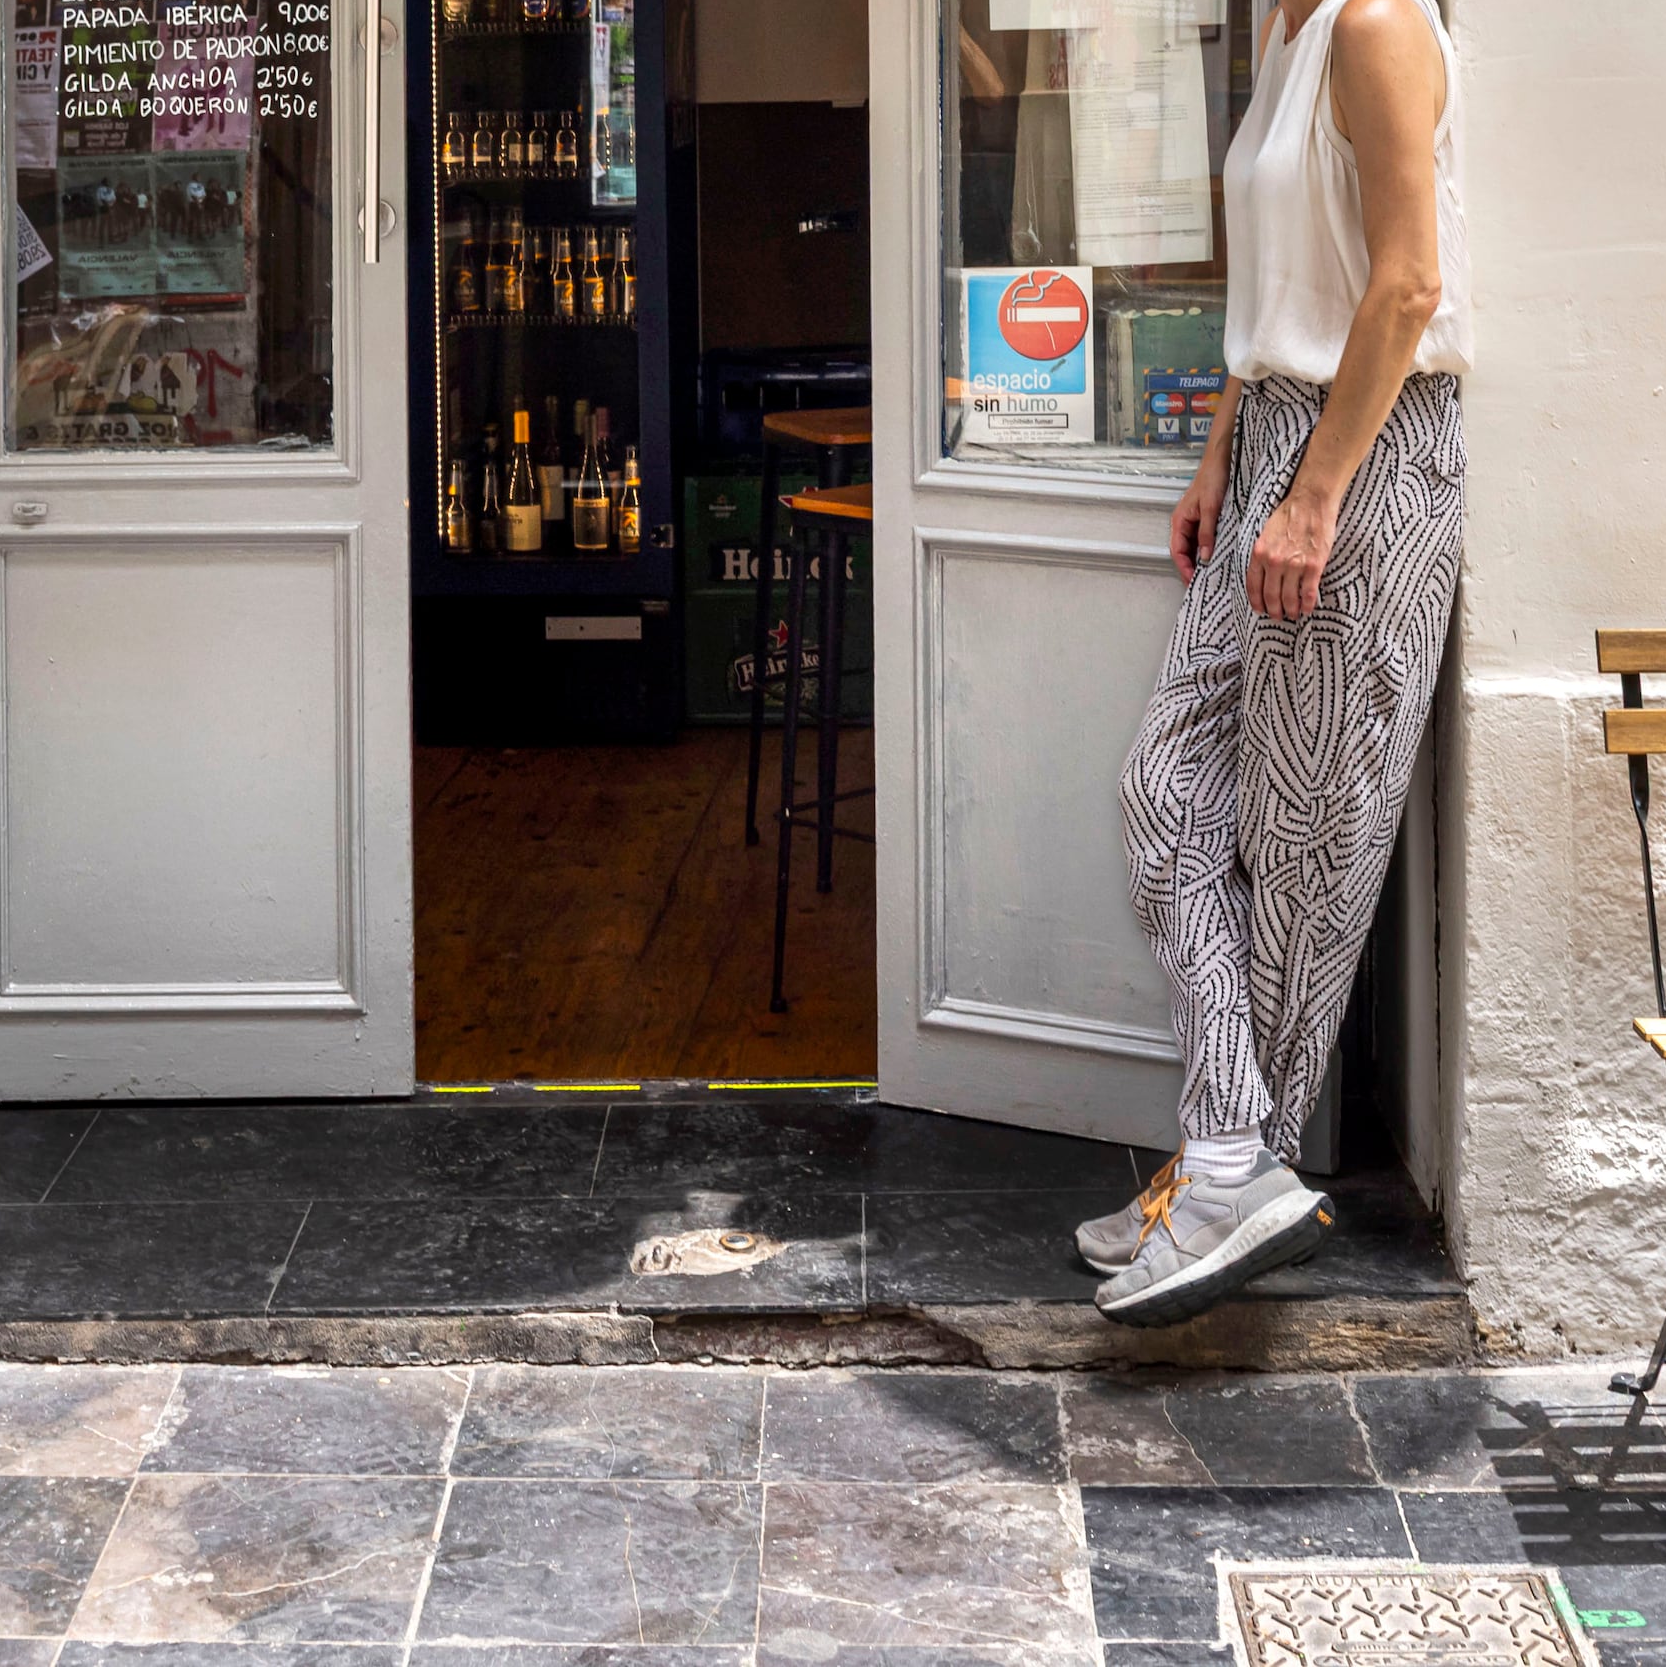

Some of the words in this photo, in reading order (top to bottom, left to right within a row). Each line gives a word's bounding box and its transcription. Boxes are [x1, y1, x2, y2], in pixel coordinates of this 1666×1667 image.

[63, 6, 150, 29] PAPADA
[166, 0, 248, 26] IBÉRICA
[278, 1, 330, 26] 9,00€
[64, 39, 165, 65] PIMIENTO
[173, 38, 198, 60] DE
[205, 23, 281, 61] PADRÓN
[283, 32, 329, 55] 8,00€
[64, 71, 133, 93] GILDA
[147, 66, 238, 93] ANCHOA
[64, 98, 123, 119] GILDA
[140, 87, 248, 118] BOQUERÓN
[974, 369, 1051, 394] espacio
[1179, 377, 1219, 387] TELEPAGO
[974, 396, 999, 412] sin
[1007, 396, 1057, 412] humo
[1164, 420, 1173, 430] V
